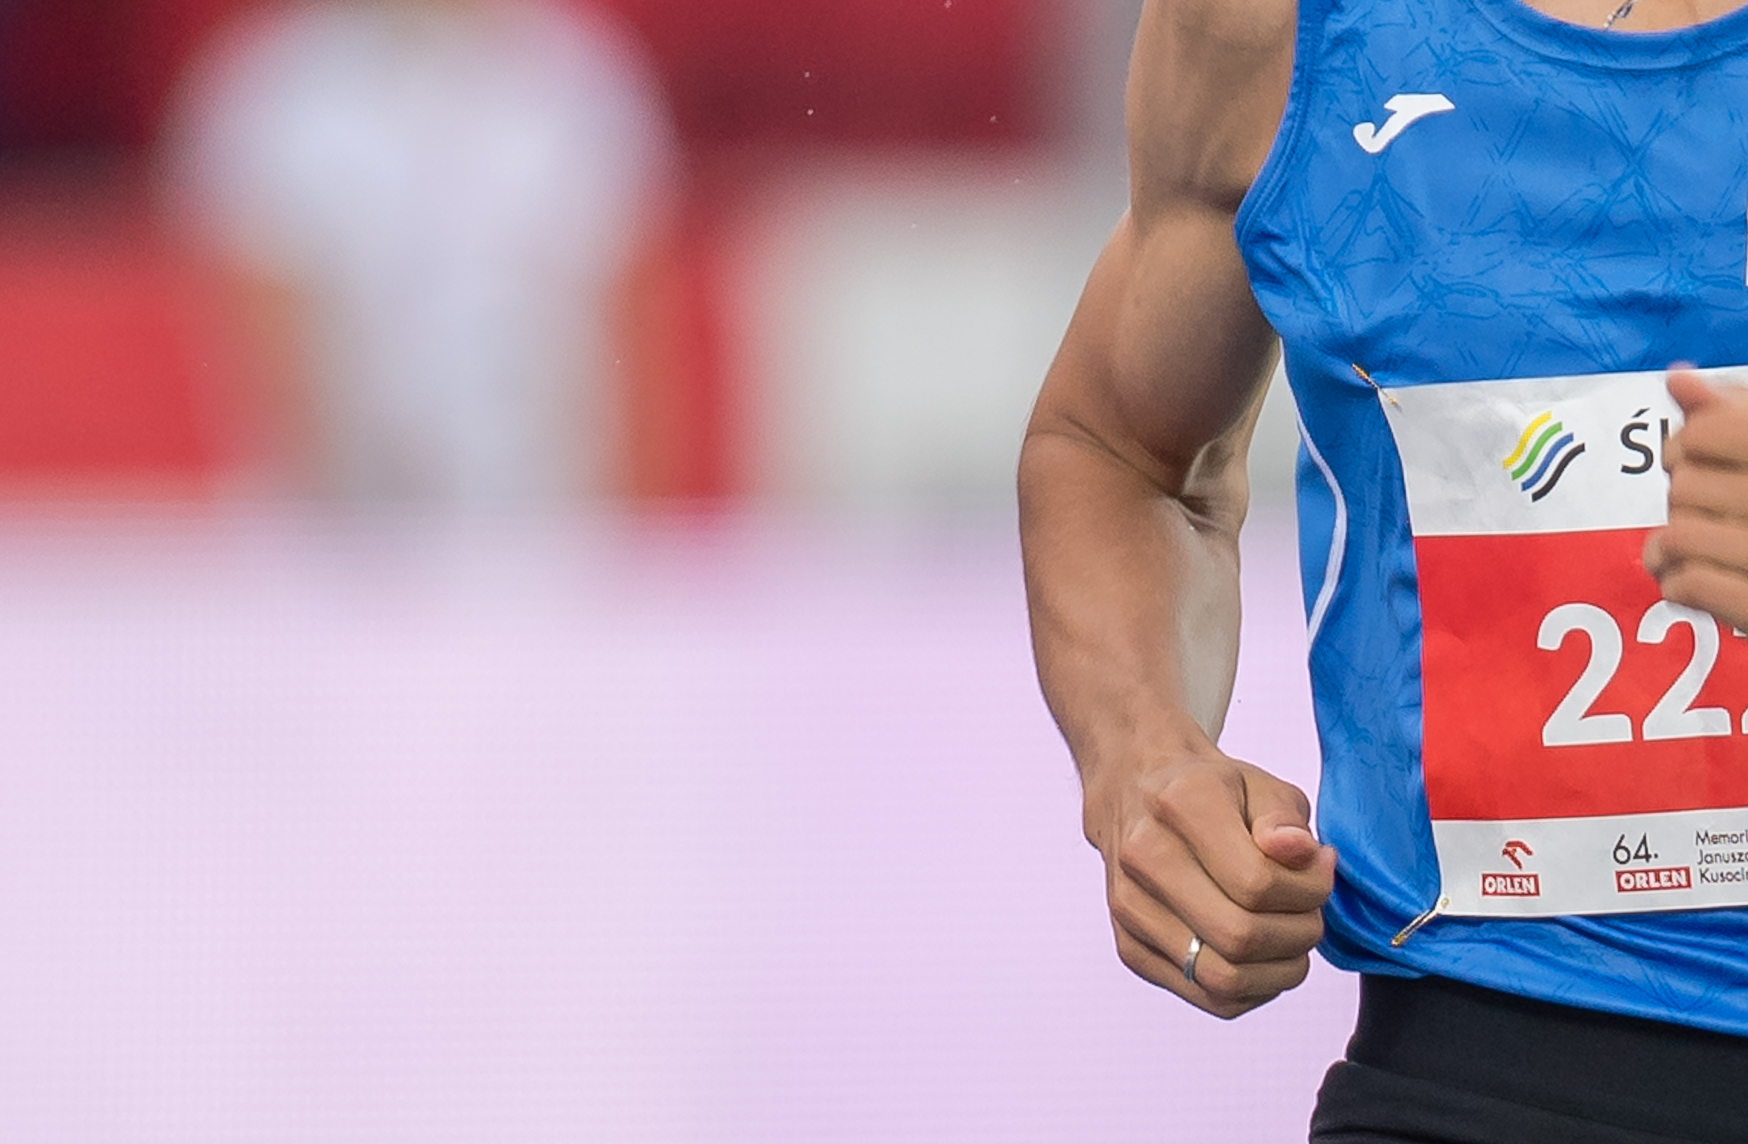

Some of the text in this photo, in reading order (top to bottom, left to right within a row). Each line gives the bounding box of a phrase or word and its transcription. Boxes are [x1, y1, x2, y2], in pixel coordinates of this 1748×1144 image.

[1612, 832, 1659, 865] 64.
[1484, 876, 1536, 894] ORLEN
[1620, 869, 1688, 890] ORLEN
